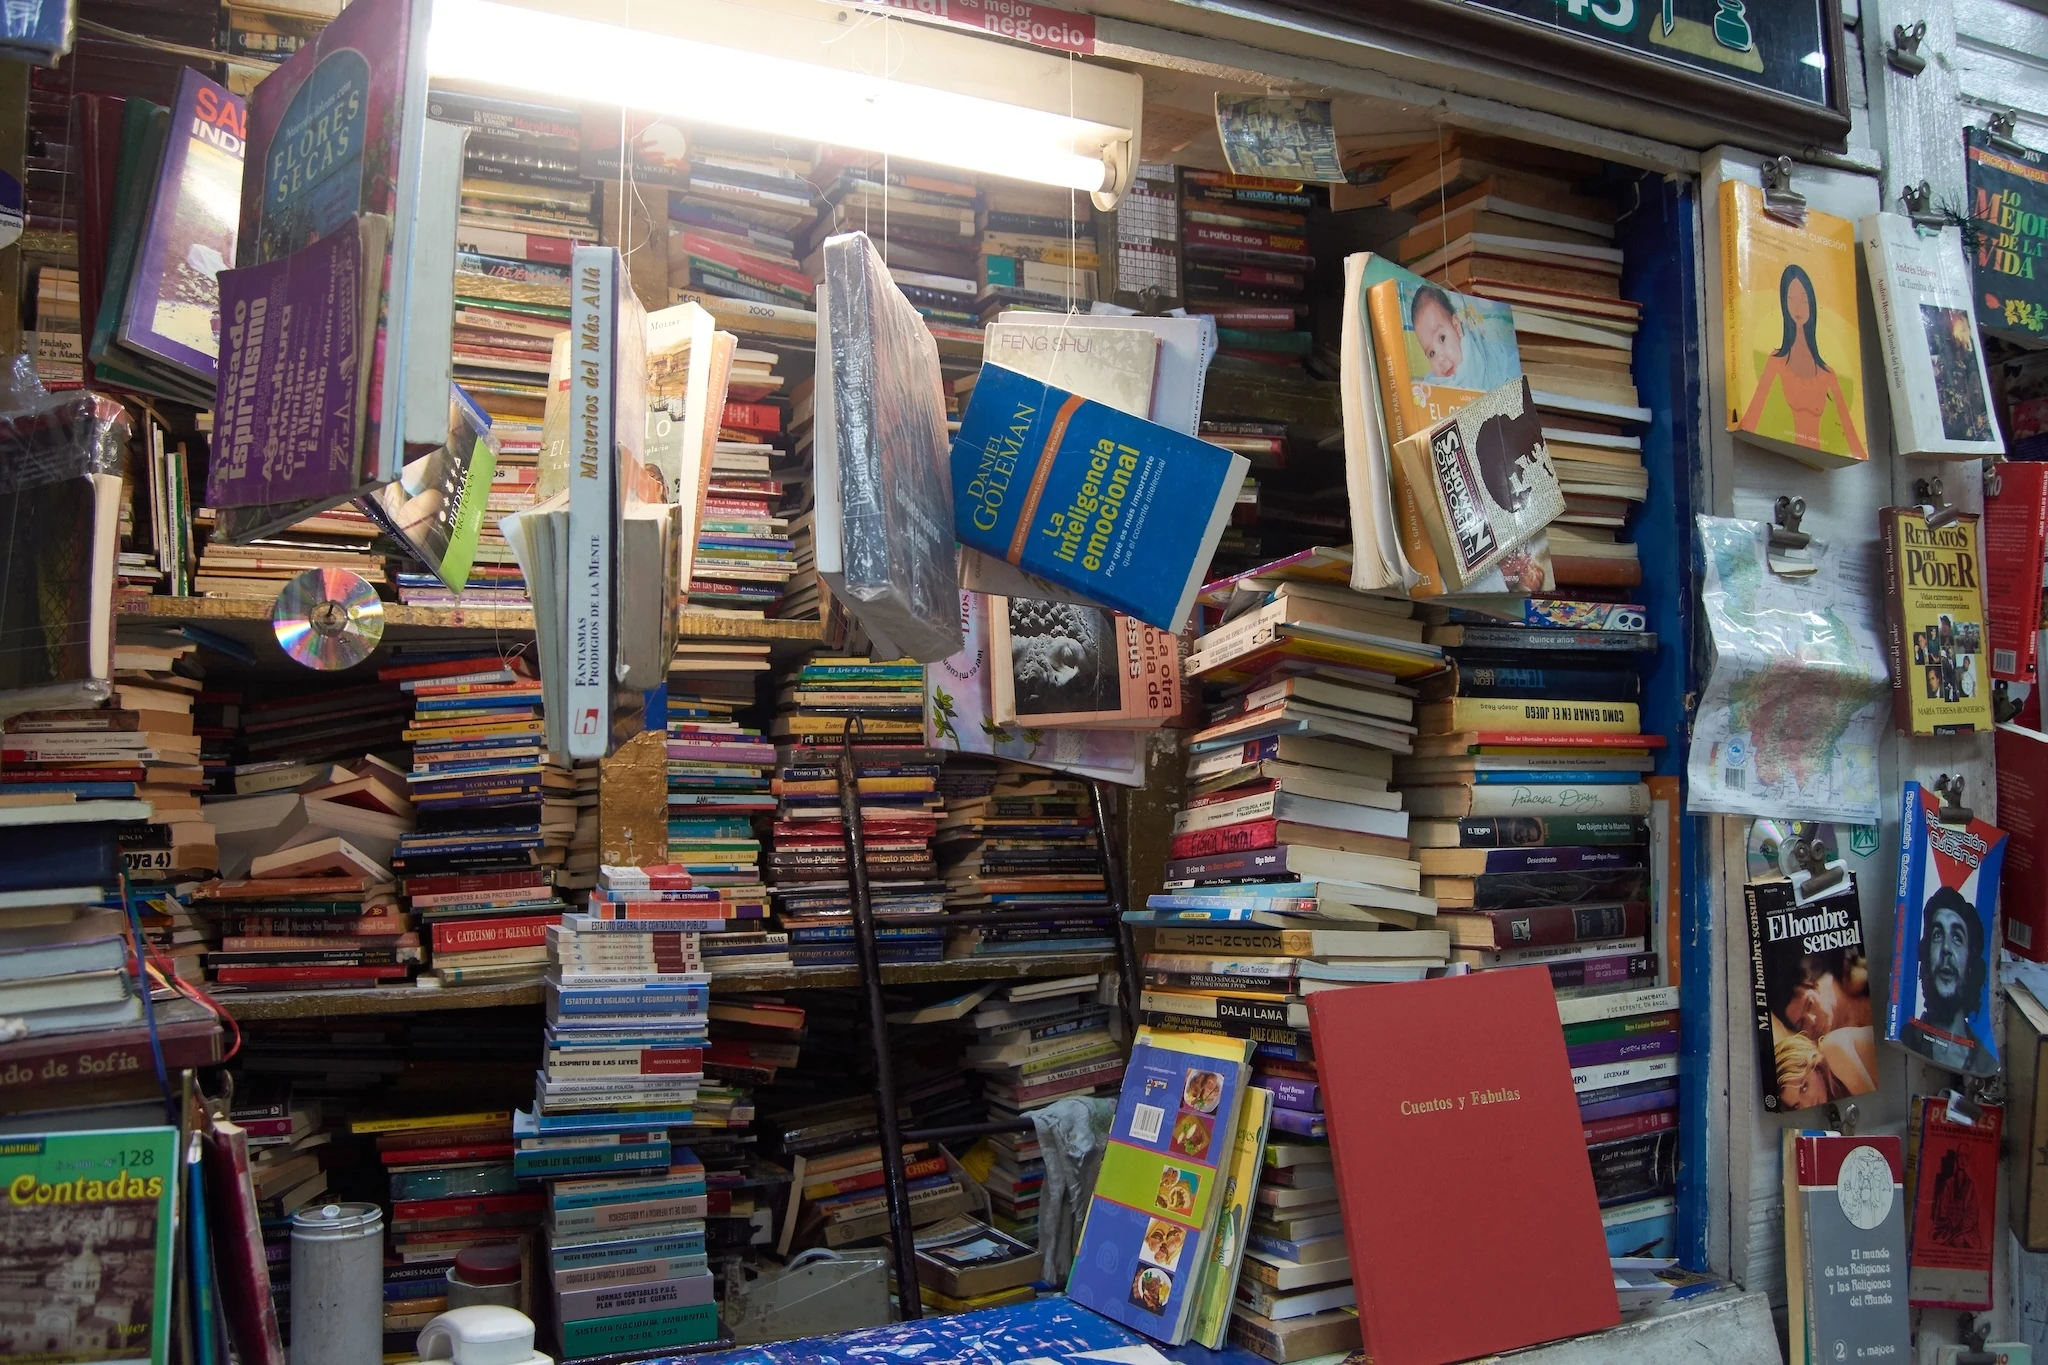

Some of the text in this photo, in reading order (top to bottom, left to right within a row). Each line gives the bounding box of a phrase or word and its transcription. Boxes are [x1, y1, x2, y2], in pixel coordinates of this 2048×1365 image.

[960, 0, 979, 9] es
[984, 0, 1032, 18] mejor
[984, 13, 1085, 46] negocio
[273, 90, 360, 181] FLORES
[278, 127, 349, 202] SECAS
[1979, 152, 2046, 182] EDICIÓN AMPLIADA
[2002, 189, 2021, 207] LO
[1231, 233, 1242, 242] DE
[1243, 235, 1262, 245] DIOS
[1796, 228, 1807, 237] de
[1809, 233, 1847, 252] curación
[1999, 232, 2043, 257] DE LA
[1978, 233, 2035, 280] VIDA
[738, 272, 785, 294] MAMA COCA
[677, 293, 775, 317] MEGA 2000
[40, 338, 72, 349] Hidalgo
[1001, 335, 1093, 353] FENG SHUI
[580, 267, 600, 480] Misterios del Más Allá
[217, 300, 247, 483] Trincado
[229, 297, 267, 479] Espiritismo
[262, 305, 292, 481] Agricultura
[275, 361, 294, 471] La Mujer
[283, 347, 306, 480] Comunismo
[294, 370, 317, 469] La Magia
[967, 434, 1004, 500] DANIEL
[973, 402, 1036, 531] GOLEMAN
[449, 467, 468, 528] PIEDRAS
[1053, 438, 1115, 562] inteligencia
[1442, 431, 1492, 553] NOMBRES
[1082, 444, 1140, 571] emocional
[1106, 455, 1155, 577] Por qué es más importante
[1123, 458, 1166, 567] que el cociente intelectual
[1043, 512, 1065, 537] La
[1904, 522, 1968, 548] RETRATOS
[1923, 550, 1938, 562] DEL
[1907, 550, 1977, 588] PODER
[588, 535, 600, 687] PRODIGIOS DE LA MENTE
[1529, 636, 1554, 644] Quince
[1892, 623, 1900, 644] poder
[575, 618, 586, 687] FANTASMAS
[1126, 616, 1140, 679] esús
[1145, 623, 1158, 710] toria de
[1158, 631, 1173, 709] La otra
[1893, 658, 1902, 689] Retratos
[1525, 706, 1624, 722] COMO GANAR EN EL JUEGO
[1936, 706, 1956, 715] TERESA
[1957, 706, 1985, 714] RONDEROS
[1512, 786, 1603, 813] Princesa Daisy
[796, 855, 839, 864] Vera Peiffer
[900, 854, 930, 862] positivo
[1527, 856, 1557, 864] Desestrésate
[1930, 831, 1979, 869] Cubana
[458, 926, 530, 943] CATECISMO IGLESIA
[1766, 906, 1849, 942] El hombre
[1804, 920, 1861, 955] sensual
[1748, 889, 1771, 1031] M. El hombre sensual
[603, 996, 636, 1004] VIGILANCIA
[642, 995, 673, 1003] SEGURIDAD
[1165, 1015, 1222, 1028] COMO GANAR AMIGOS
[1221, 1005, 1283, 1021] DALAI LAMA
[1250, 1027, 1297, 1046] DALE CARNEGIE
[42, 1059, 68, 1078] de
[1400, 1088, 1521, 1115] Cuentos y Fabulas
[119, 1149, 154, 1167] 128
[528, 1155, 601, 1169] NUEVA LEY DE VICTIMAS
[906, 1159, 940, 1176] CHING
[10, 1169, 164, 1206] Contadas
[582, 1252, 607, 1260] REFORMA
[608, 1248, 637, 1257] TRIBUTARIA
[1851, 1248, 1889, 1260] El mundo
[390, 1268, 418, 1278] AMORES
[1825, 1263, 1890, 1276] de las Religiones
[596, 1292, 622, 1302] NORMAS
[624, 1289, 659, 1299] CONTABLES
[1829, 1279, 1891, 1295] y las Religiones
[1850, 1296, 1862, 1306] del
[575, 1312, 709, 1336] SISTEMA NACIONAL AMBIENTAL
